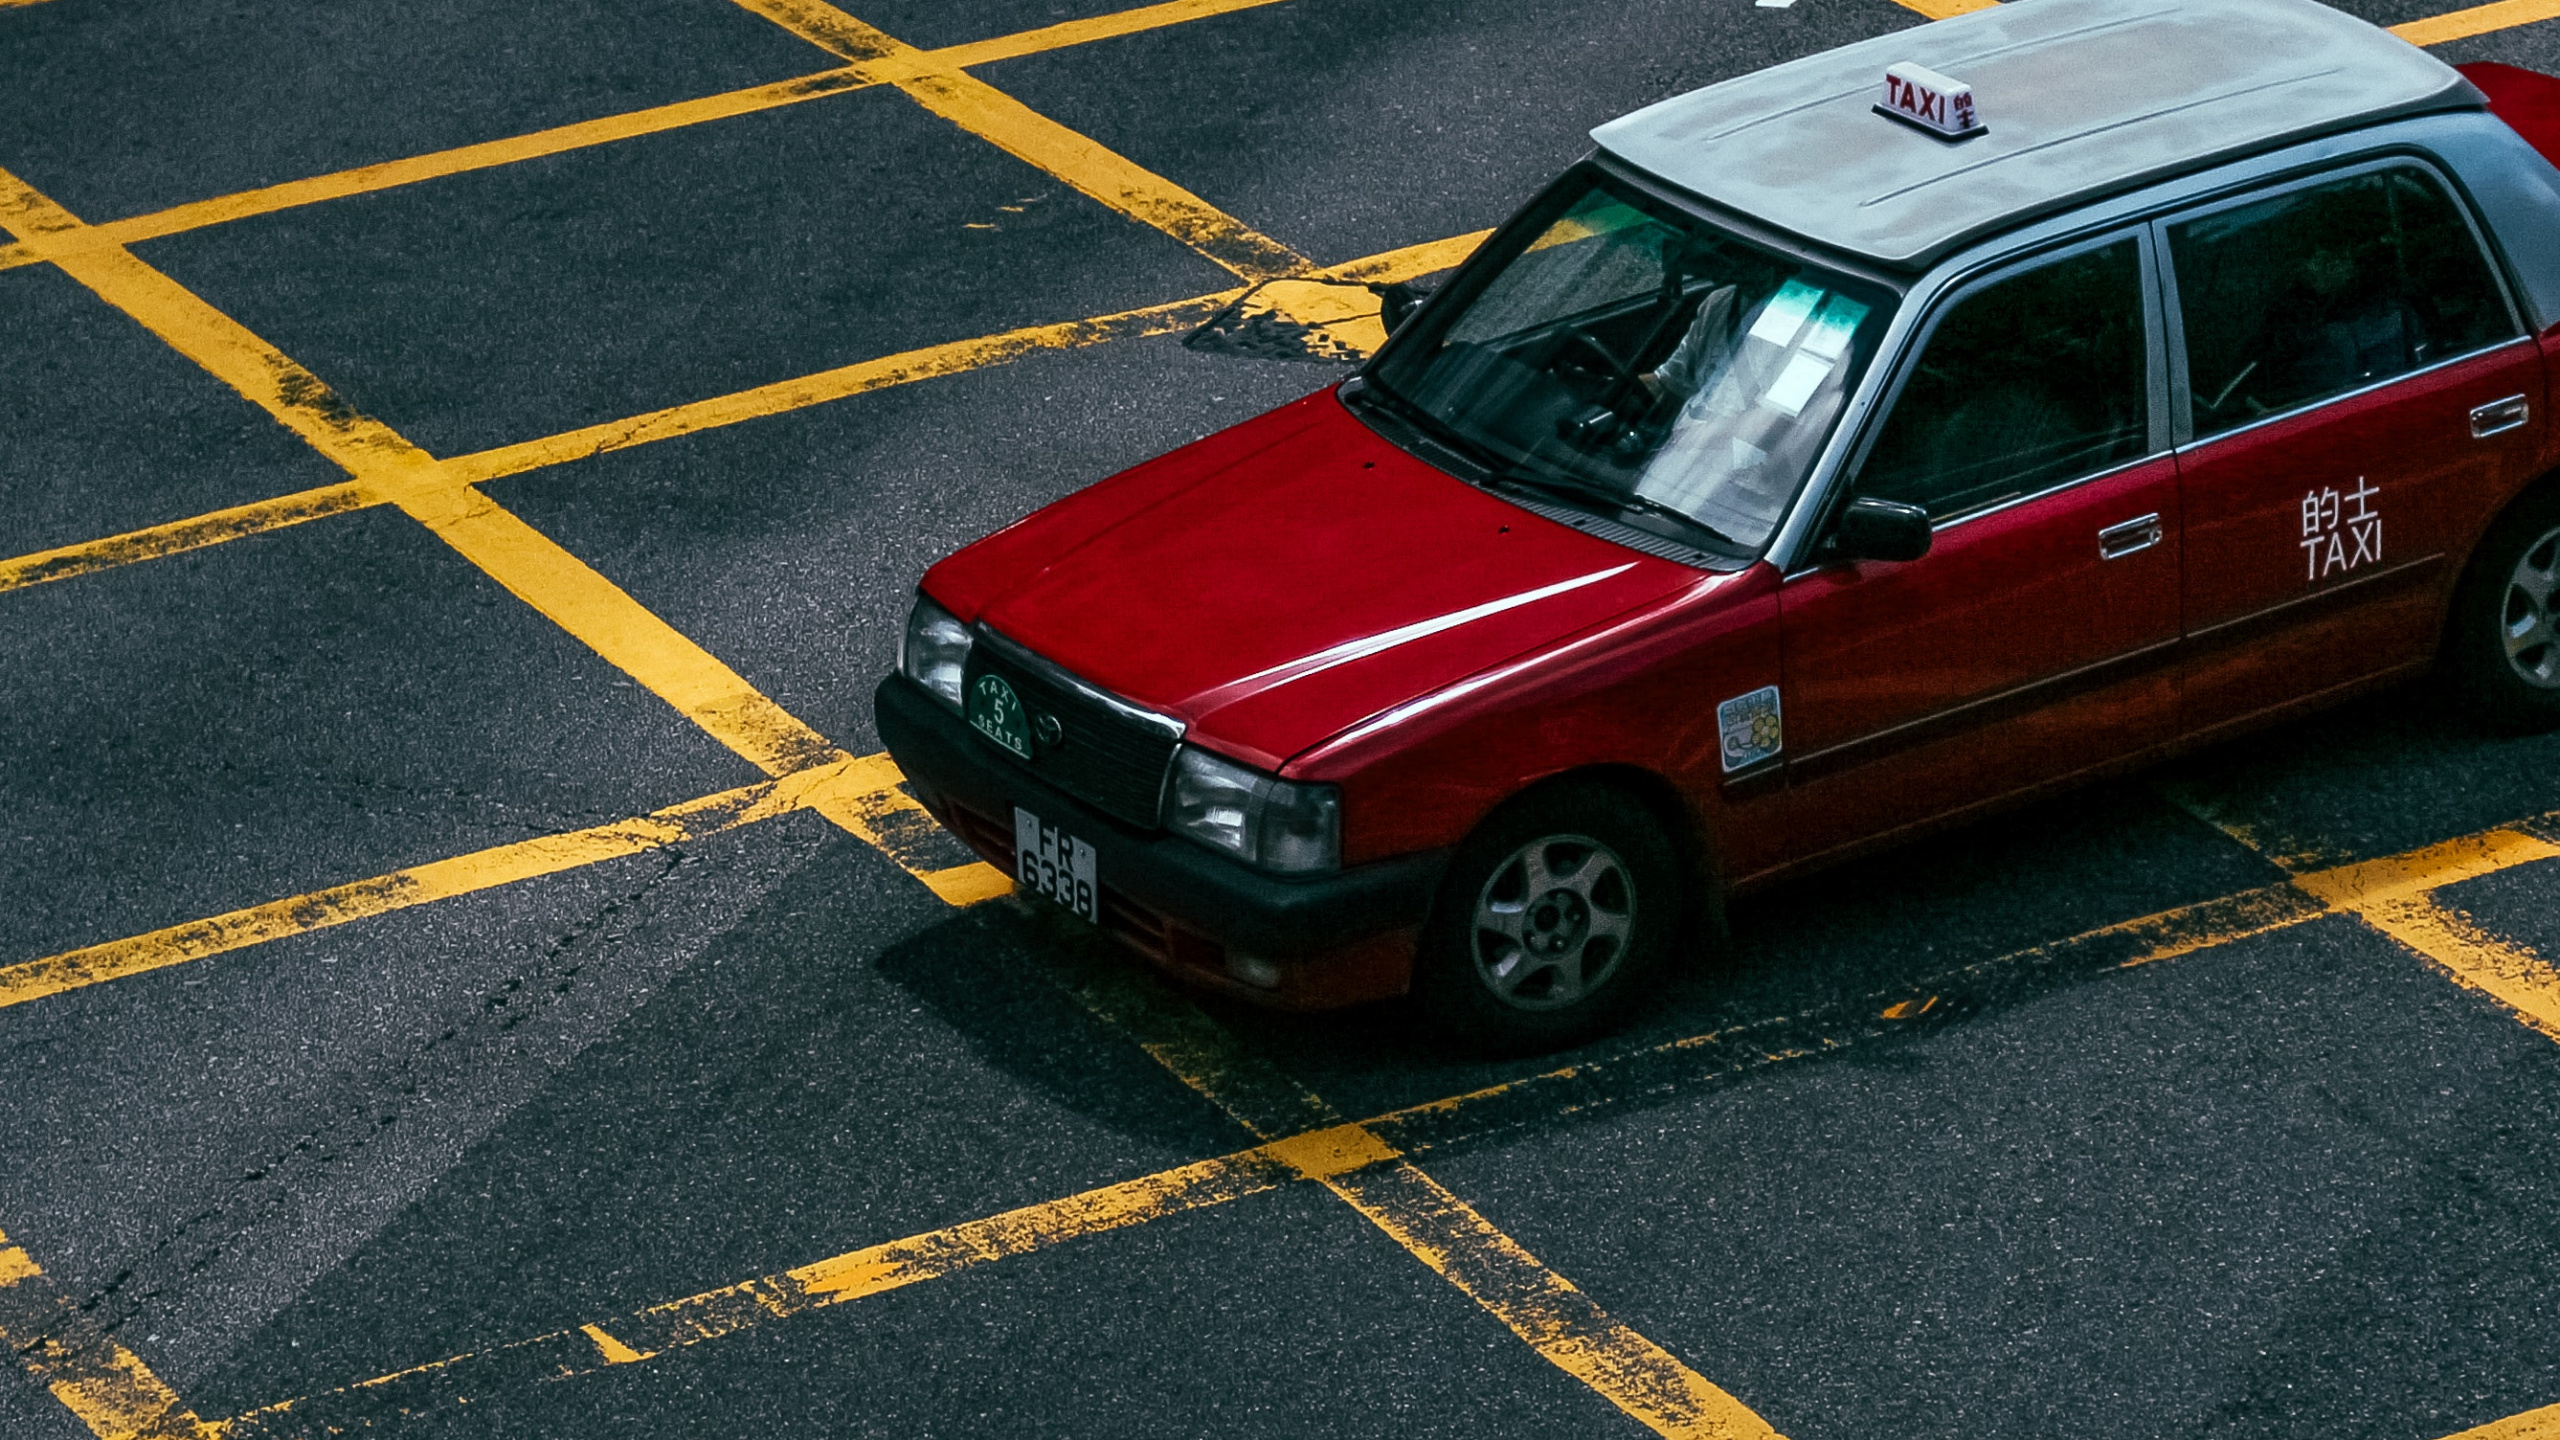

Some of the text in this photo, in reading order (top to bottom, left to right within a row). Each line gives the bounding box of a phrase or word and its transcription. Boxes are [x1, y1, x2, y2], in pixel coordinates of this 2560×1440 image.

[1886, 73, 1945, 125] TAXI
[2302, 476, 2380, 537] 的士
[2300, 519, 2381, 580] TAXI
[979, 681, 1016, 711] TAXI
[994, 698, 1004, 725] 5
[978, 714, 1022, 751] SEATS
[1039, 820, 1074, 873] FR
[1022, 849, 1092, 918] 6338
